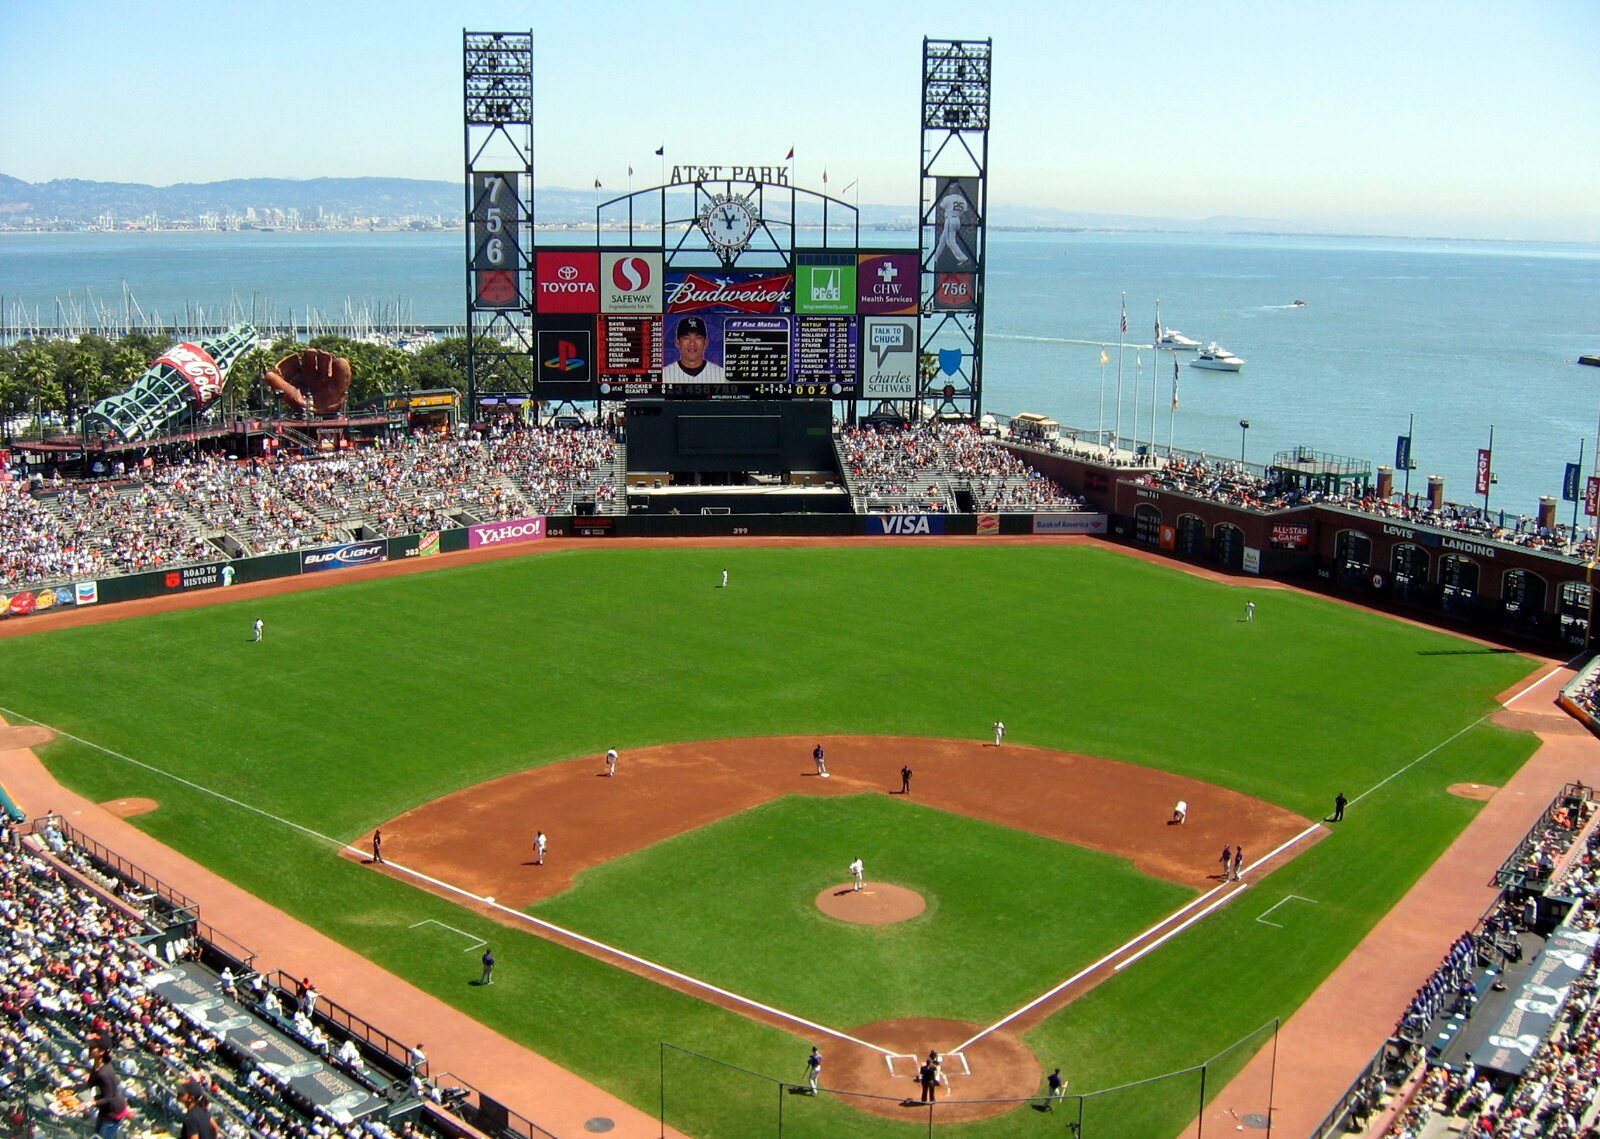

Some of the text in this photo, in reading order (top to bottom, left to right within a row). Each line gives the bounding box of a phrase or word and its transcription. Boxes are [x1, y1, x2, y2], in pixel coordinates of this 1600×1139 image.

[670, 166, 788, 186] AT&T PARK
[952, 202, 964, 212] 25
[484, 177, 502, 263] 756
[541, 282, 595, 292] TOYOTA
[664, 280, 791, 304] Budweiser
[873, 284, 902, 294] CHW
[942, 282, 967, 296] 756
[612, 295, 652, 303] SAFEWAY
[813, 287, 839, 300] PG&E
[869, 371, 911, 383] charles
[796, 386, 826, 394] 0 0 2
[868, 384, 912, 392] SCHWAB
[882, 516, 930, 534] VISA
[475, 521, 540, 544] YAHOO!
[405, 548, 419, 556] 382
[1442, 538, 1495, 557] LANDING
[305, 546, 382, 564] BUD LIGHT
[183, 567, 205, 578] ROAD
[184, 575, 217, 587] HISTORY
